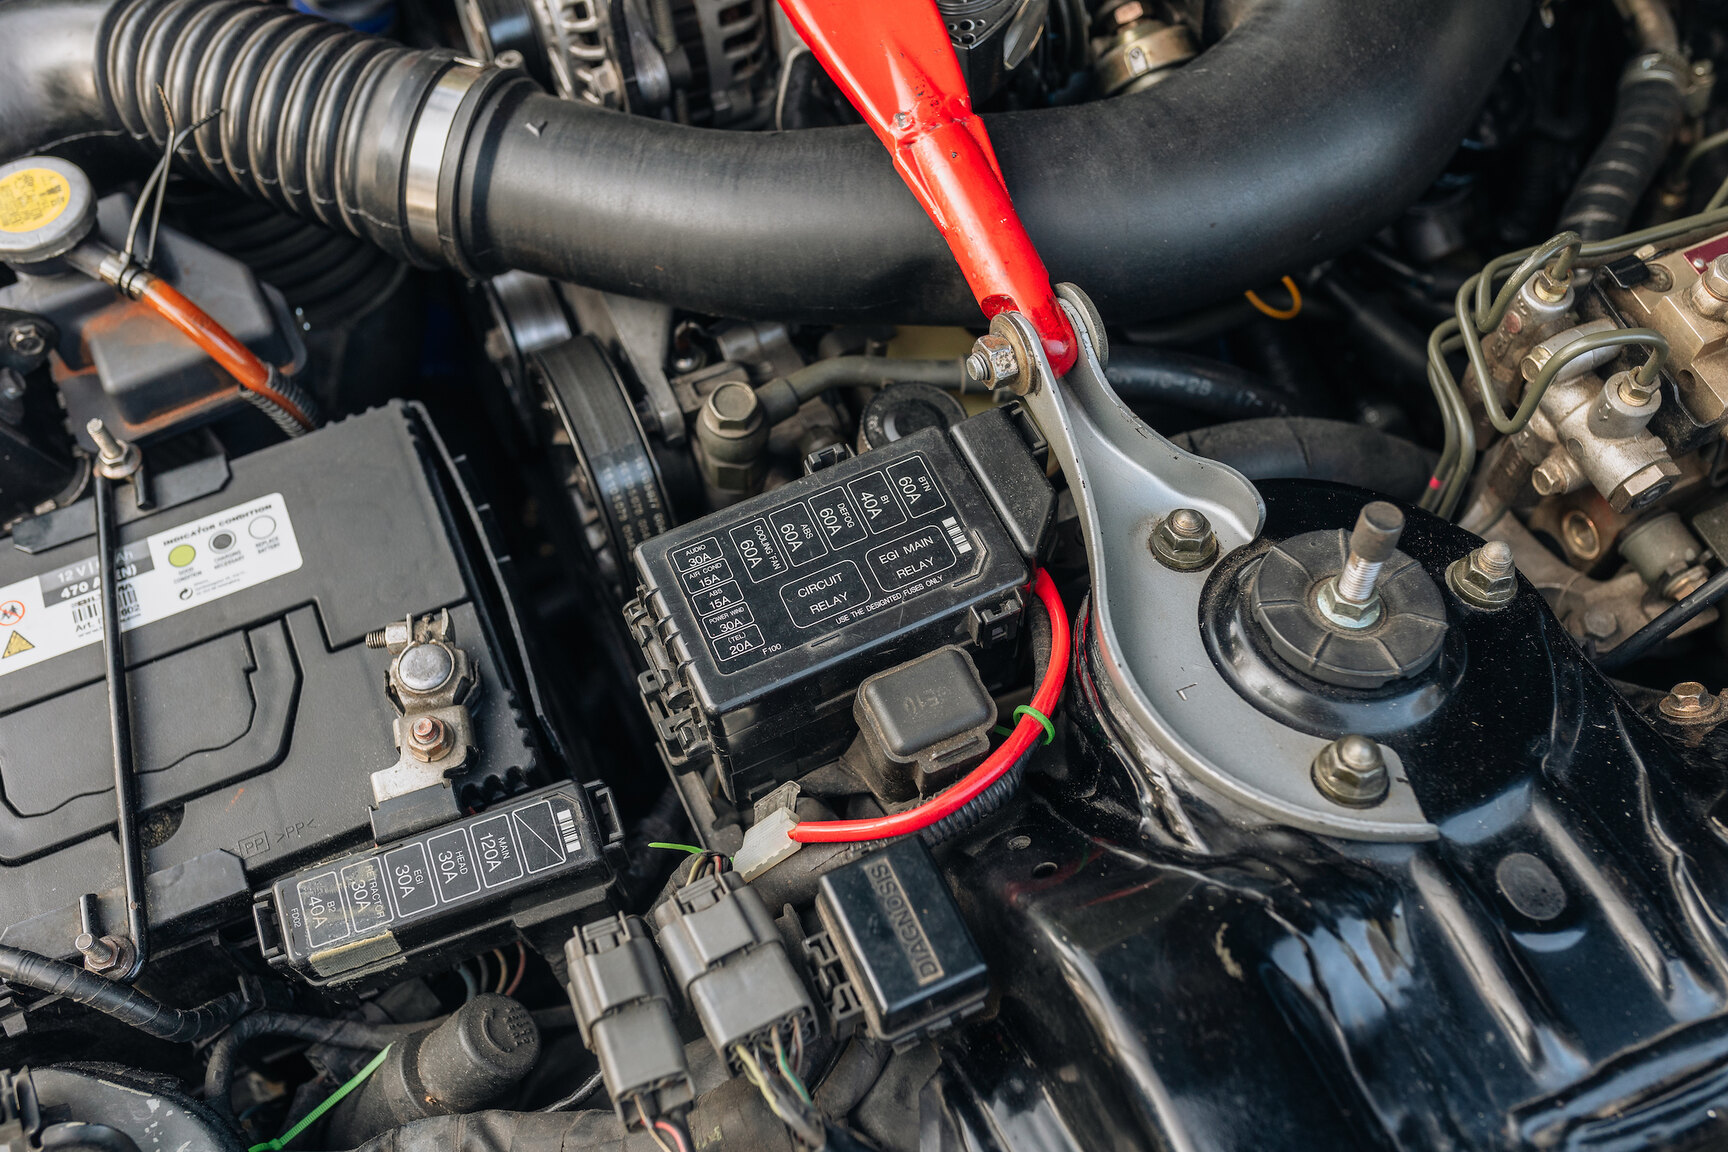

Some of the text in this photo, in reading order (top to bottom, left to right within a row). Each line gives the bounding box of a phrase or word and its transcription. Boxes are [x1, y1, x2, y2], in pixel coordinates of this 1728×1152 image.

[898, 476, 922, 505] 60A
[918, 475, 932, 492] BTN
[861, 492, 883, 520] 40A
[880, 494, 890, 505] B1
[218, 504, 272, 527] CONDITION
[819, 507, 842, 537] 60A
[836, 502, 856, 528] DEFOG
[780, 523, 804, 552] 60A
[800, 524, 814, 540] ABS
[685, 544, 706, 556] AUDIO
[740, 539, 763, 569] 60A
[753, 525, 782, 571] COOLING FAN
[878, 536, 934, 566] EGI MAIN
[688, 552, 712, 568] 30A
[689, 562, 722, 580] AIR COND
[896, 557, 936, 580] RELAY
[58, 570, 74, 583] 12
[76, 564, 86, 577] V
[699, 574, 721, 588] 15A
[797, 572, 842, 598] CIRCUIT
[61, 581, 89, 599] 470
[708, 588, 723, 598] ABS
[836, 613, 850, 625] USE
[850, 607, 865, 619] THE
[903, 582, 924, 596] FUSES
[925, 574, 944, 588] ONLY
[709, 596, 732, 610] 15A
[809, 591, 850, 615] RELAY
[708, 606, 745, 625] POWER WIND
[719, 618, 744, 634] 30A
[728, 632, 746, 644] (TEL)
[729, 641, 754, 656] 20A
[762, 643, 782, 656] F100
[244, 837, 264, 854] PP
[480, 832, 502, 873] 120A
[498, 836, 511, 860] MAIN
[438, 850, 458, 884] 30A
[455, 850, 468, 875] HEAD
[395, 864, 416, 898] 30A
[413, 868, 424, 885] EGI
[351, 879, 372, 914] 30A
[365, 864, 386, 919] RETRACTOR
[308, 896, 328, 929] 40A
[326, 900, 336, 913] B2
[870, 864, 938, 978] DIAGNOSIS
